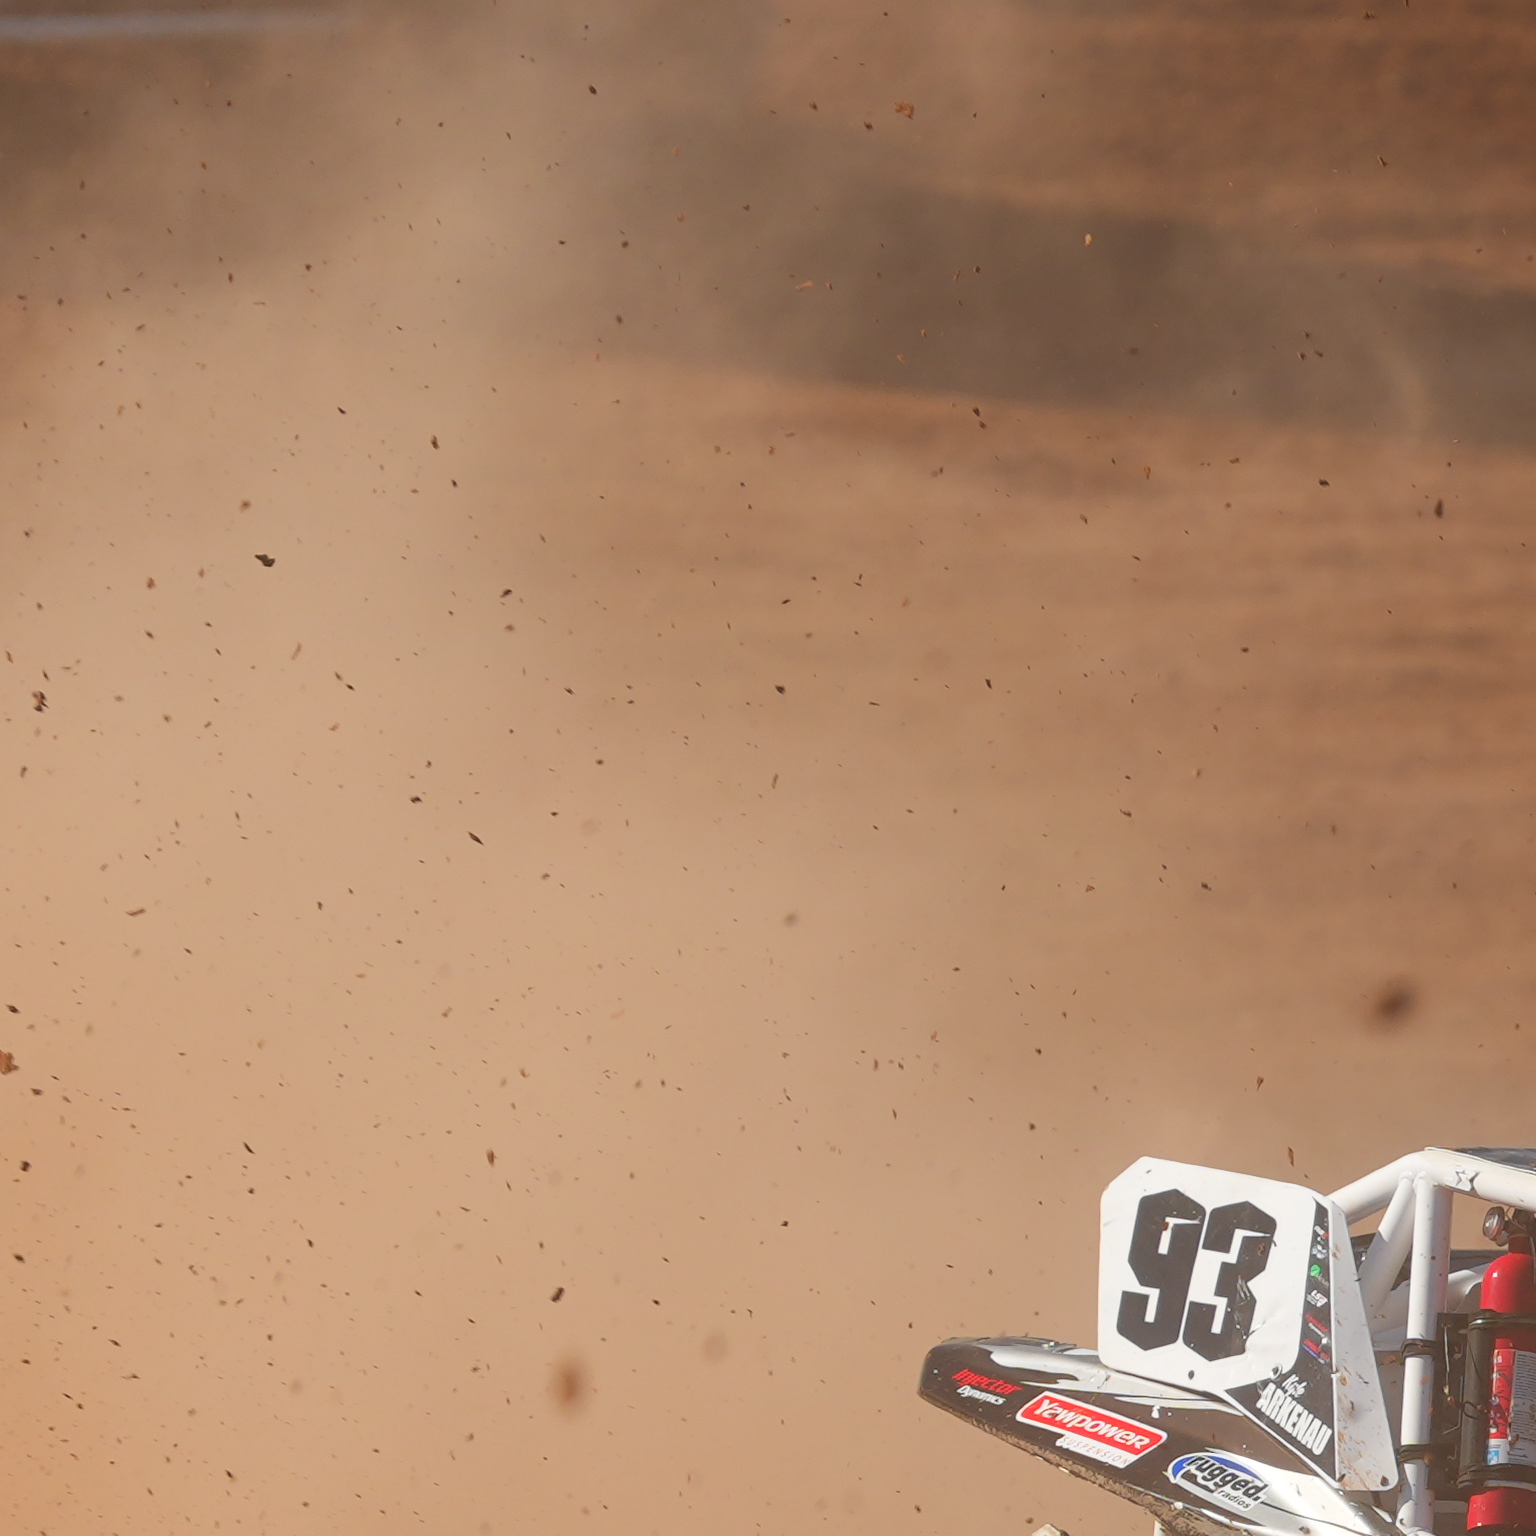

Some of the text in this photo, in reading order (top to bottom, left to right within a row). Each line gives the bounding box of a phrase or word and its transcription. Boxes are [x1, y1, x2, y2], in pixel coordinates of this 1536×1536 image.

[1115, 1187, 1278, 1362] 93
[1255, 1381, 1333, 1456] ARKENAU
[1061, 1434, 1132, 1466] SUSPENSION
[1184, 1455, 1269, 1501] rugged
[1217, 1489, 1252, 1510] radios
